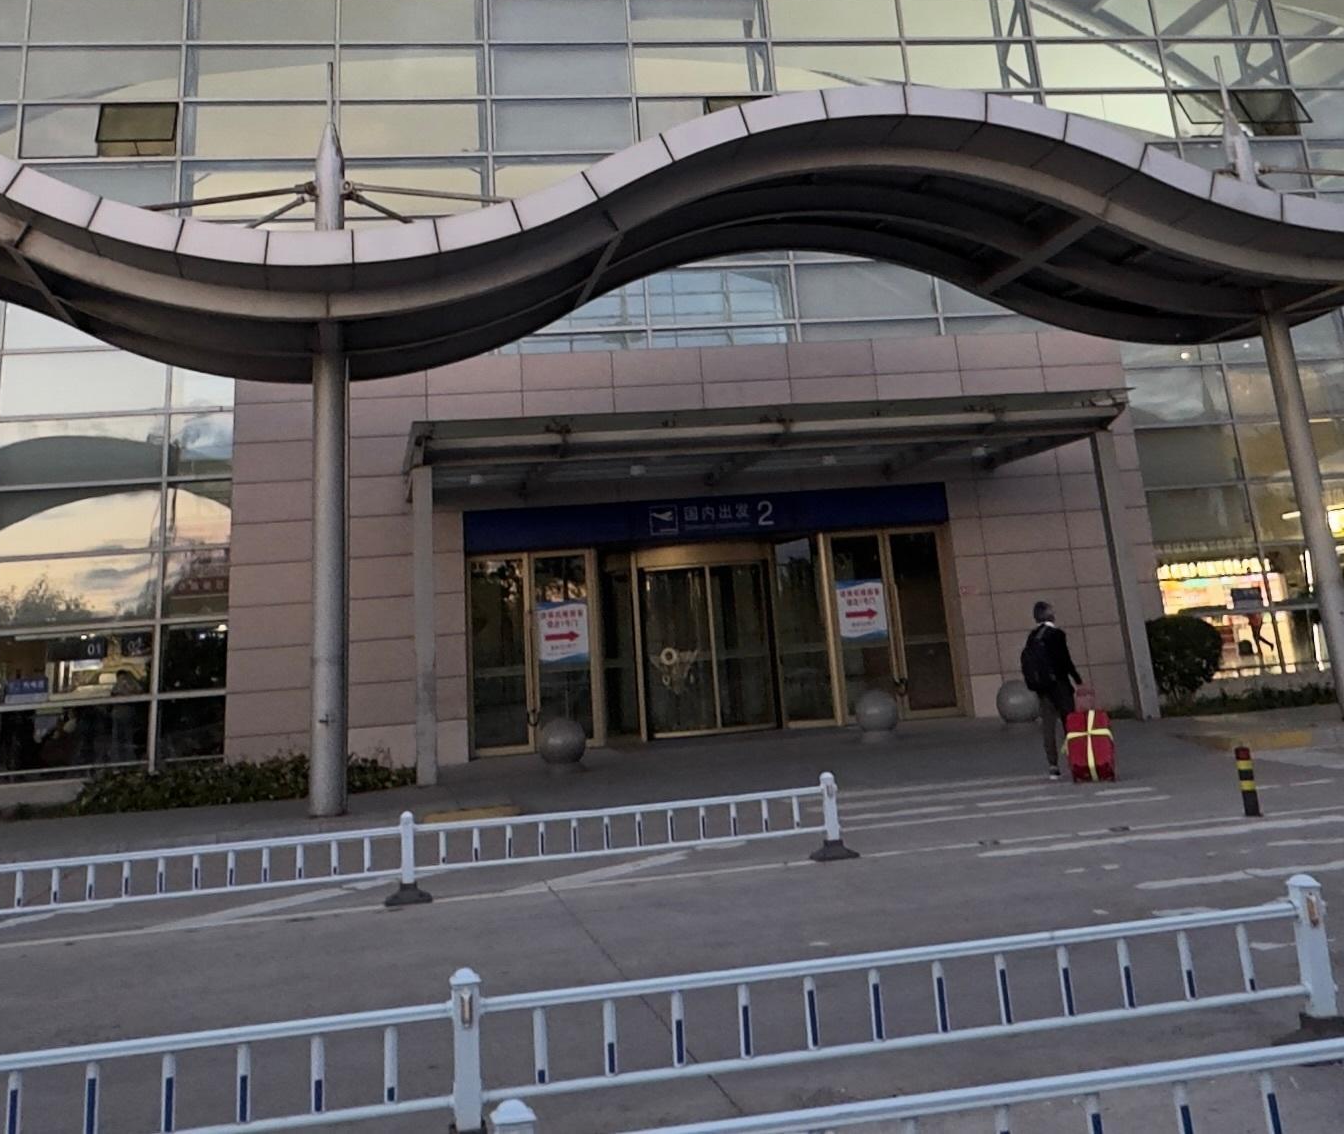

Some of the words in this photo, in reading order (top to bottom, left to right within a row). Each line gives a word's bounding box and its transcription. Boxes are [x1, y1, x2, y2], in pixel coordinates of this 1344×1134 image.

[684, 503, 750, 521] 国内出发
[757, 500, 774, 525] 2
